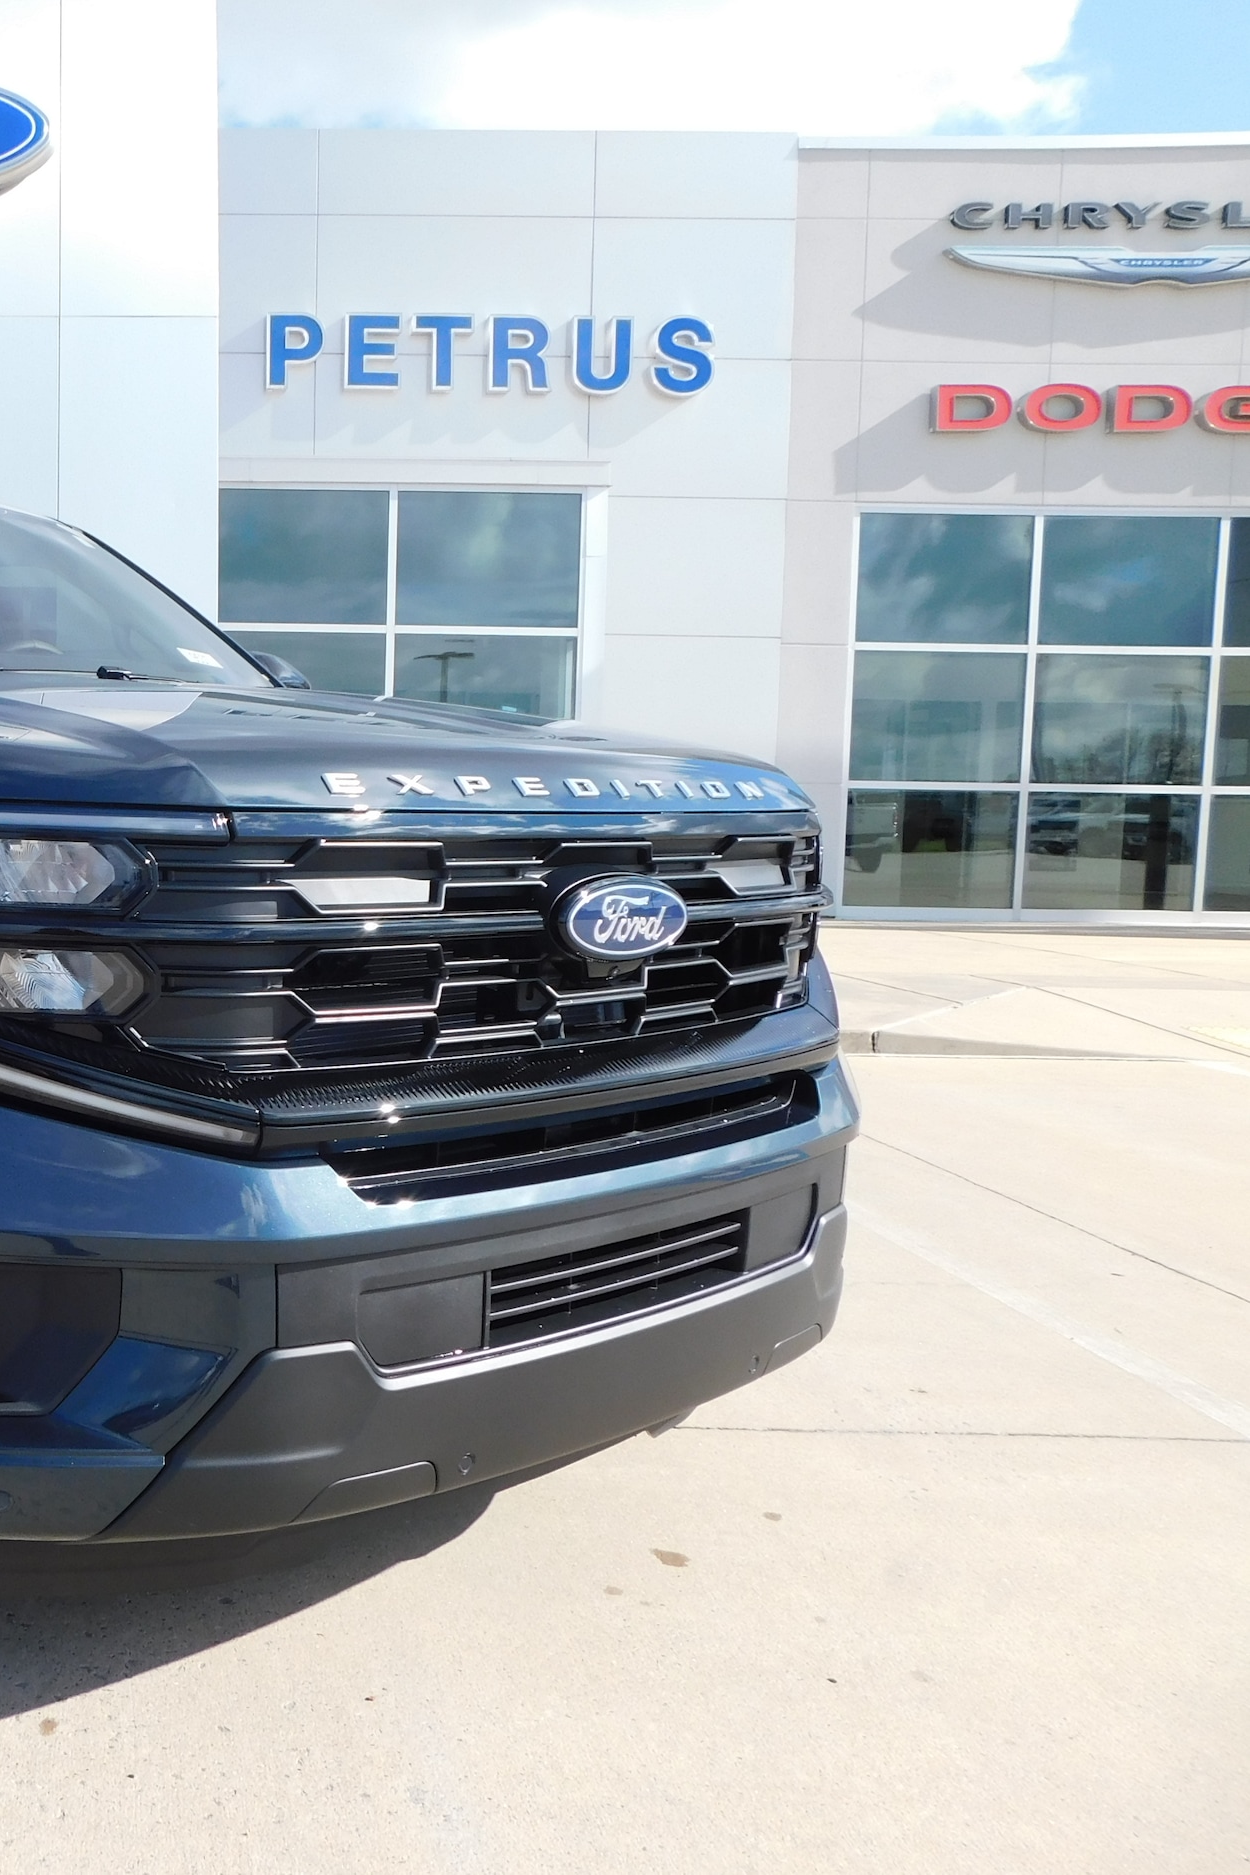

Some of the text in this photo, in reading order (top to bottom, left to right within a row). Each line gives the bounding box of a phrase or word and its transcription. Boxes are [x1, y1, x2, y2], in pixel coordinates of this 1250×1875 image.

[1120, 258, 1204, 267] CHRYSLER
[266, 312, 716, 397] PETRUS
[321, 771, 765, 800] EXPEDITION
[593, 895, 667, 944] Ford
